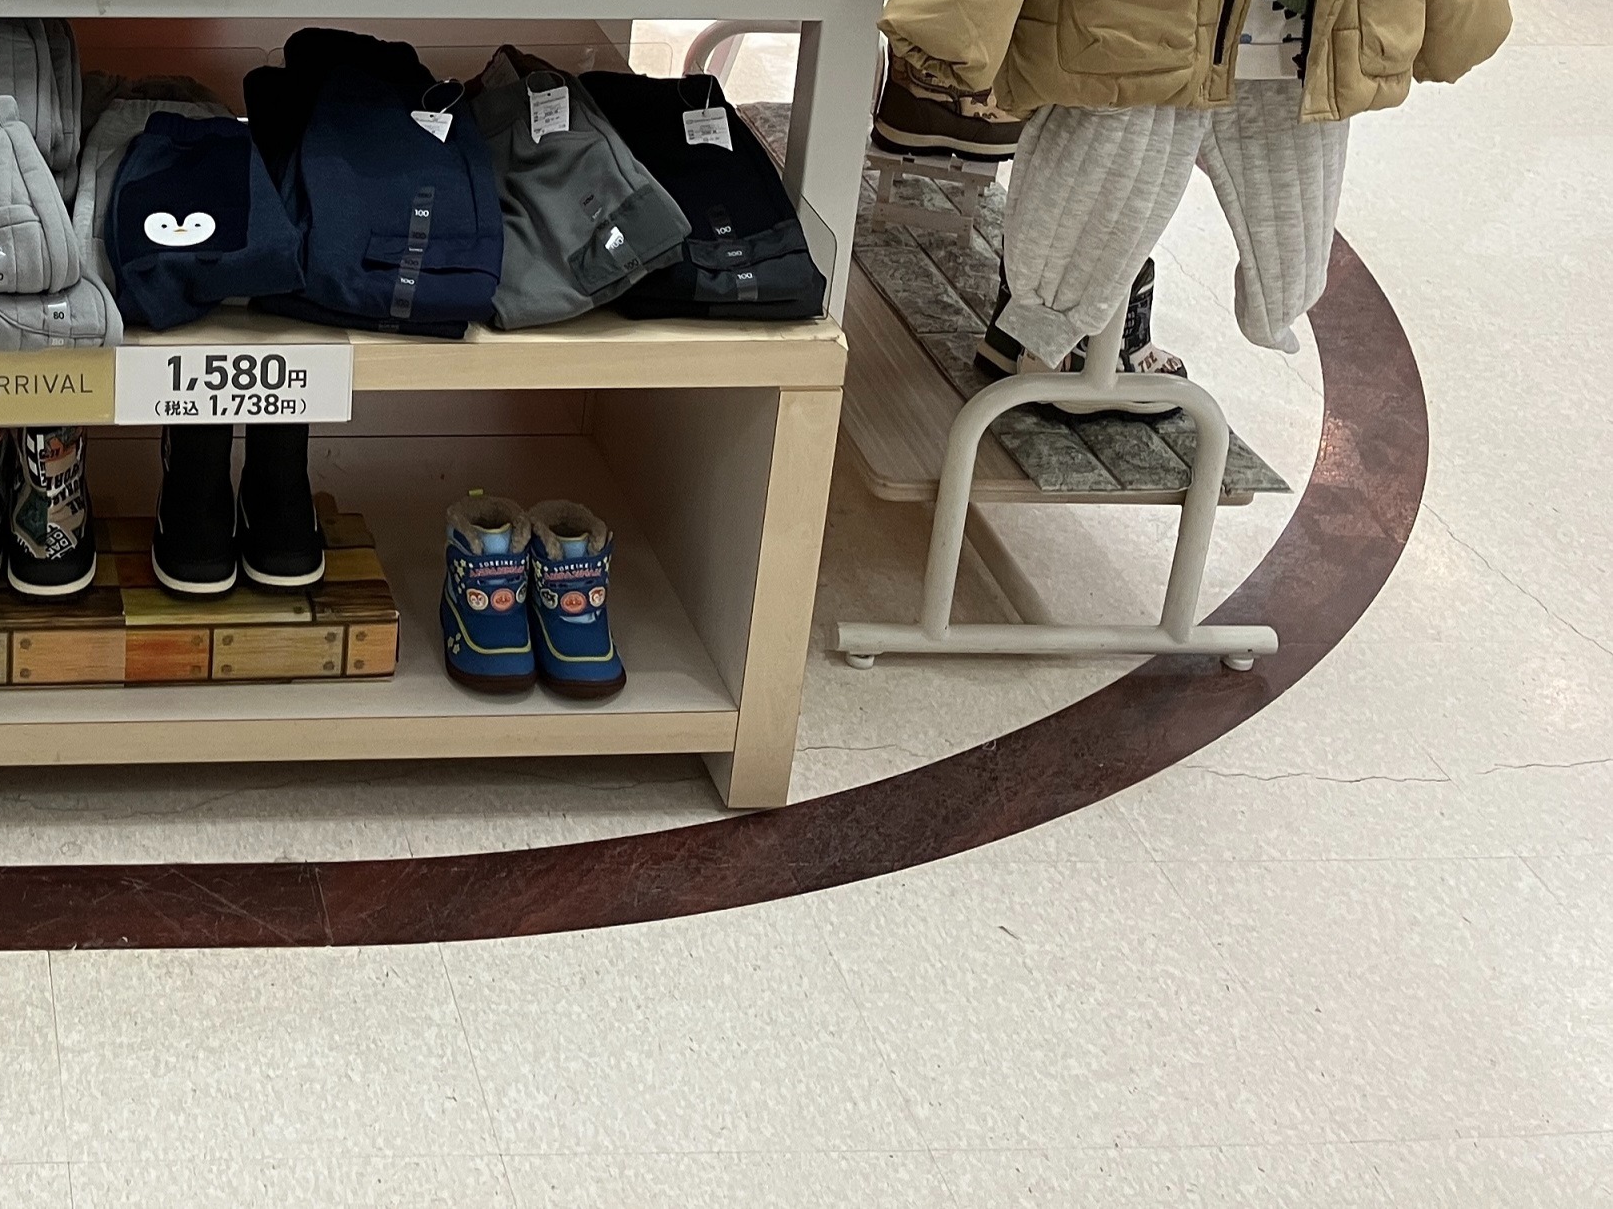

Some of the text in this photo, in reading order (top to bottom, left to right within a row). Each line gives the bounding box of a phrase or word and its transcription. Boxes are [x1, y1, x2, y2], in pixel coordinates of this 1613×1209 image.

[414, 209, 429, 217] 100
[715, 226, 731, 235] 100
[737, 272, 753, 280] 100
[400, 277, 415, 285] 100
[53, 311, 65, 320] 80
[167, 354, 308, 392] 1,580円
